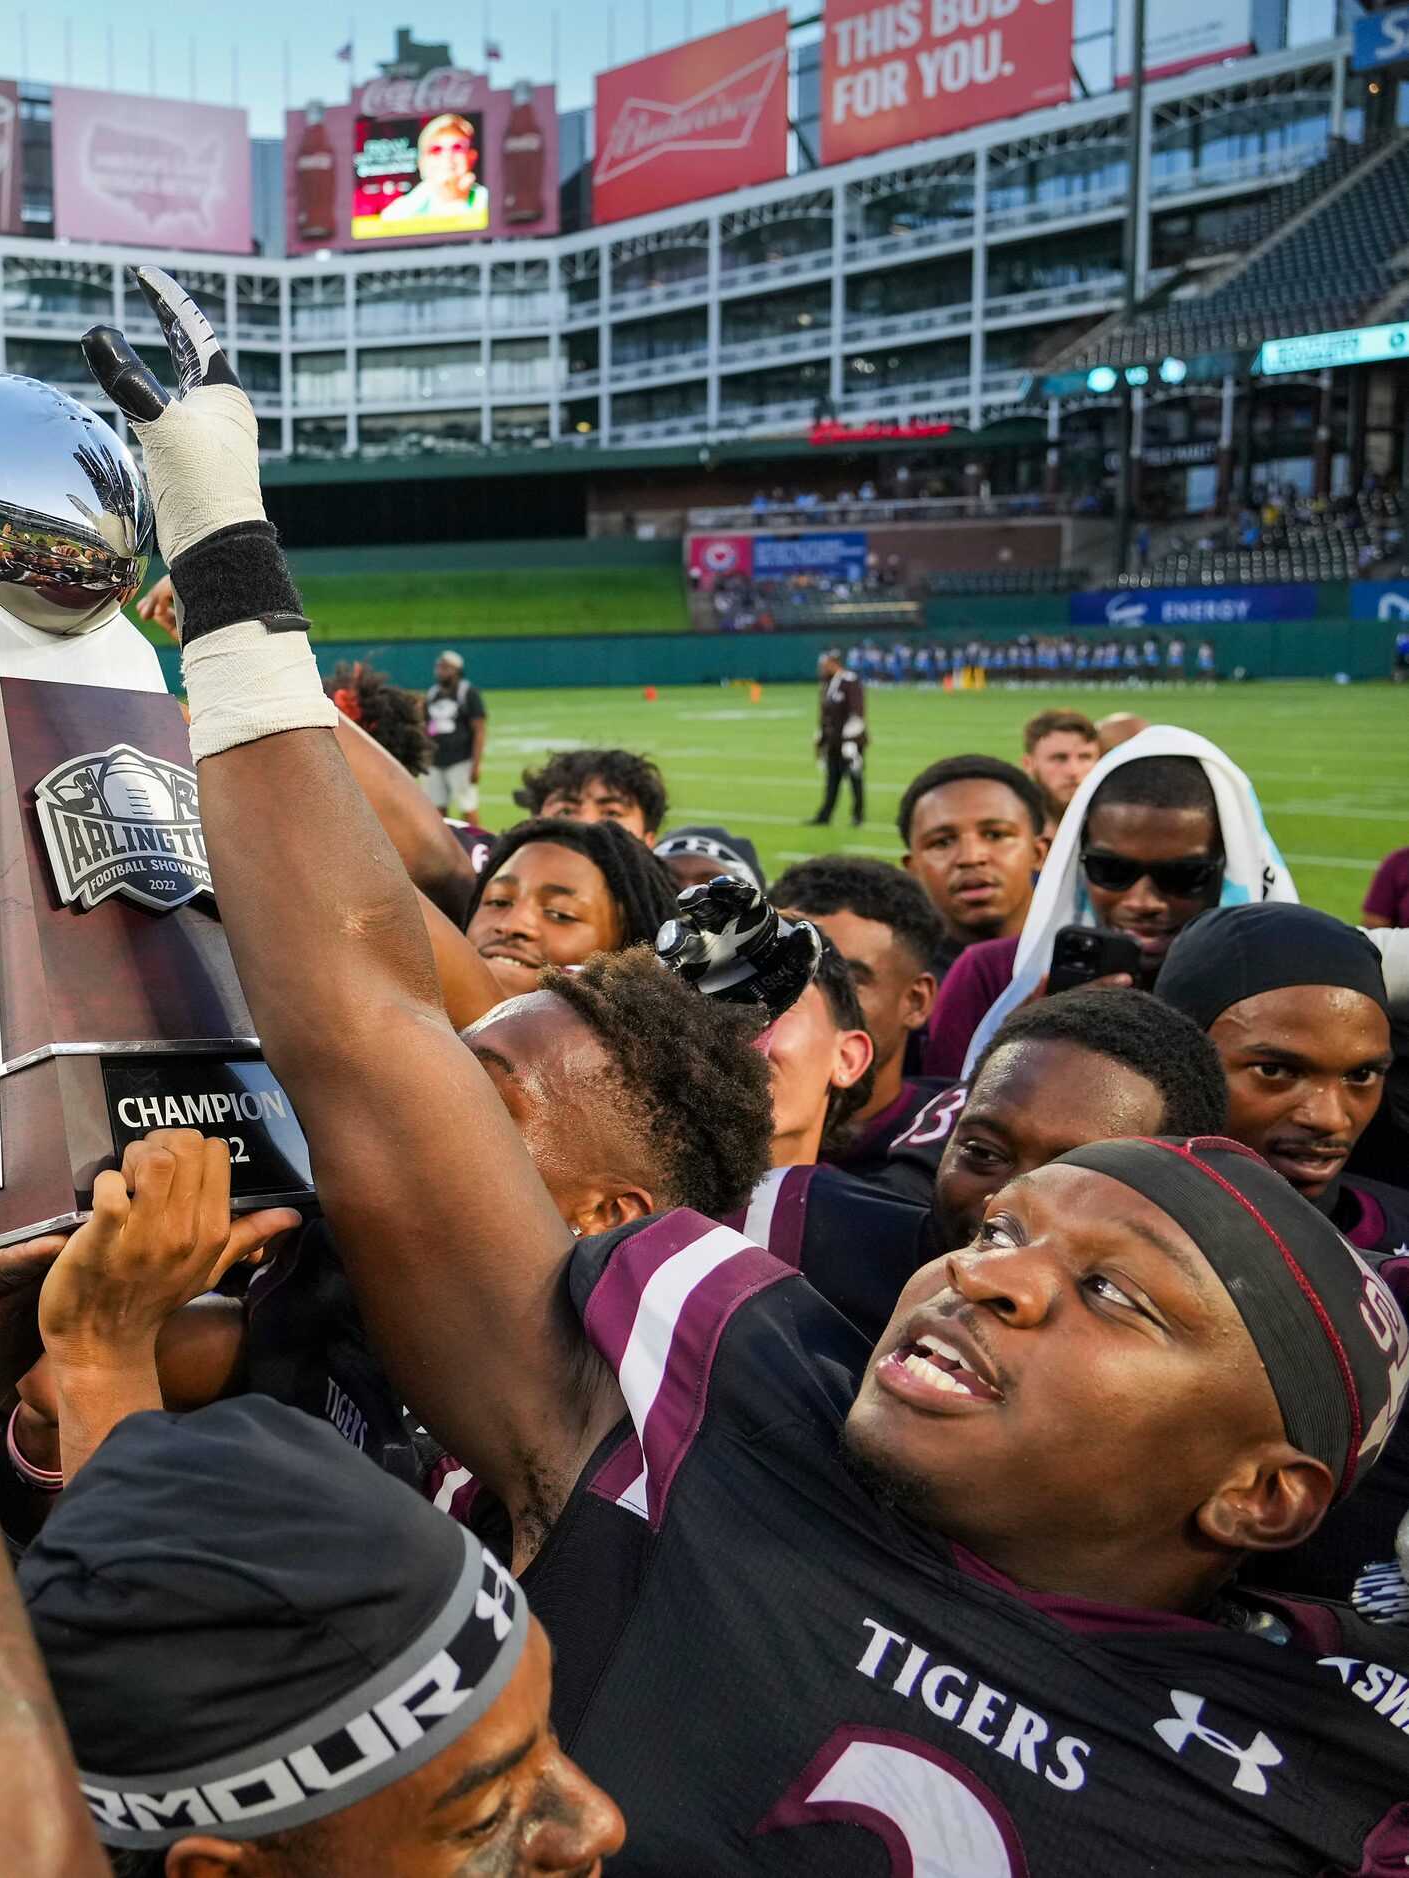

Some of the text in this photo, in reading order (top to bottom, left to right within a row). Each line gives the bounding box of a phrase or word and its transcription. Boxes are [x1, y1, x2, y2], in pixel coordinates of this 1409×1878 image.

[831, 0, 1056, 67] THIS BUD
[832, 30, 1016, 125] FOR YOU.
[1161, 598, 1251, 623] ENERGY
[62, 815, 208, 874] ARLINGTO
[90, 859, 212, 892] FOOTBALL SHOWDO
[149, 879, 178, 891] 2022
[117, 1090, 287, 1128] CHAMPION
[855, 1617, 1091, 1792] TIGERS
[80, 1648, 475, 1831] RMOUR
